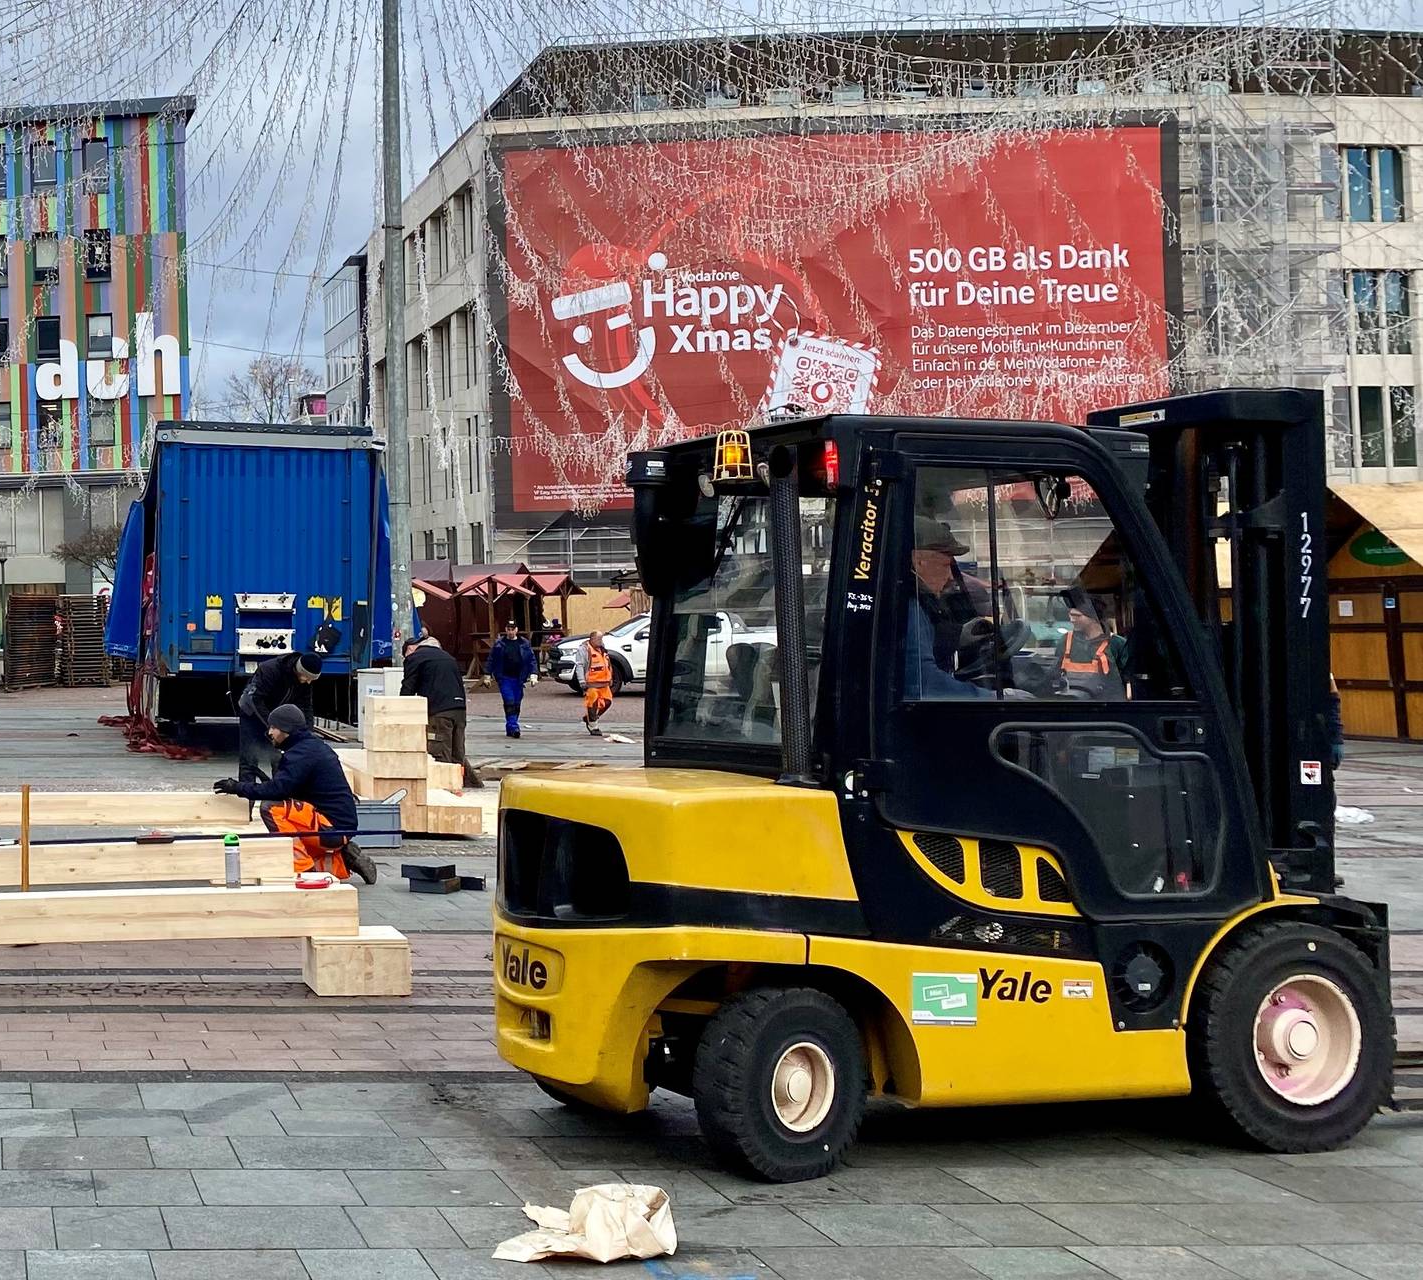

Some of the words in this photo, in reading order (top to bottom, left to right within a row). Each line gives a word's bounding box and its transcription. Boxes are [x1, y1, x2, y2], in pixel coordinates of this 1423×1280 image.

[909, 248, 962, 273] 500
[968, 247, 1006, 272] GB
[1013, 245, 1052, 271] als
[1059, 243, 1130, 269] Dank
[680, 271, 740, 282] Vodafone
[643, 279, 783, 324] Happy
[909, 282, 949, 307] für
[957, 280, 1035, 306] Deine
[1042, 279, 1119, 303] Treue
[669, 324, 774, 353] Xmas
[912, 325, 934, 338] Das
[1046, 323, 1062, 334] im
[1065, 321, 1132, 334] Dezember
[802, 343, 824, 354] Jetzt
[912, 342, 930, 355] für
[934, 342, 978, 354] unsere
[913, 358, 960, 372] Einfach
[964, 359, 976, 371] in
[980, 357, 1001, 370] der
[913, 376, 943, 389] oder
[947, 374, 966, 387] bei
[853, 500, 878, 580] Veracitor
[1300, 511, 1312, 618] 12977
[502, 941, 547, 990] Yale
[979, 968, 1052, 1003] Yale
